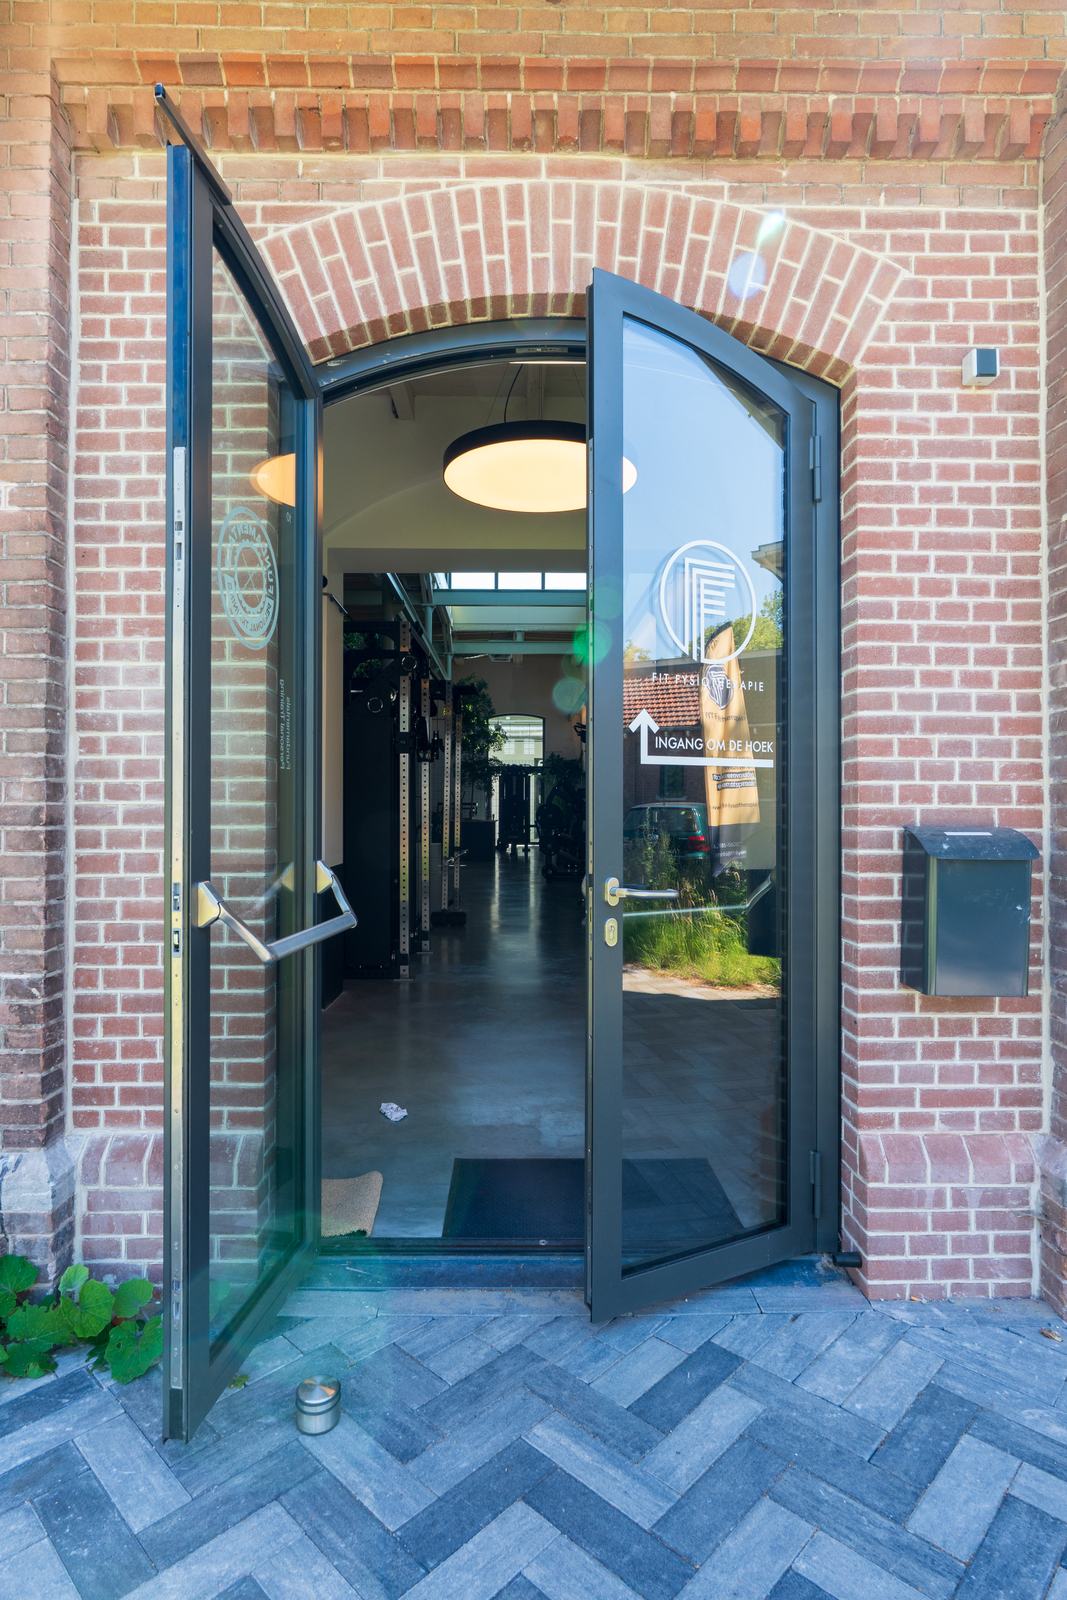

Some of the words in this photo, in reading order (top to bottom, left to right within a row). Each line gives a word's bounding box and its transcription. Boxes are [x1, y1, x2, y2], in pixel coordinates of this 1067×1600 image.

[652, 672, 670, 684] FIT
[655, 736, 704, 750] INGANG
[707, 740, 726, 751] OM
[729, 740, 743, 751] DE
[745, 740, 774, 753] HOEK
